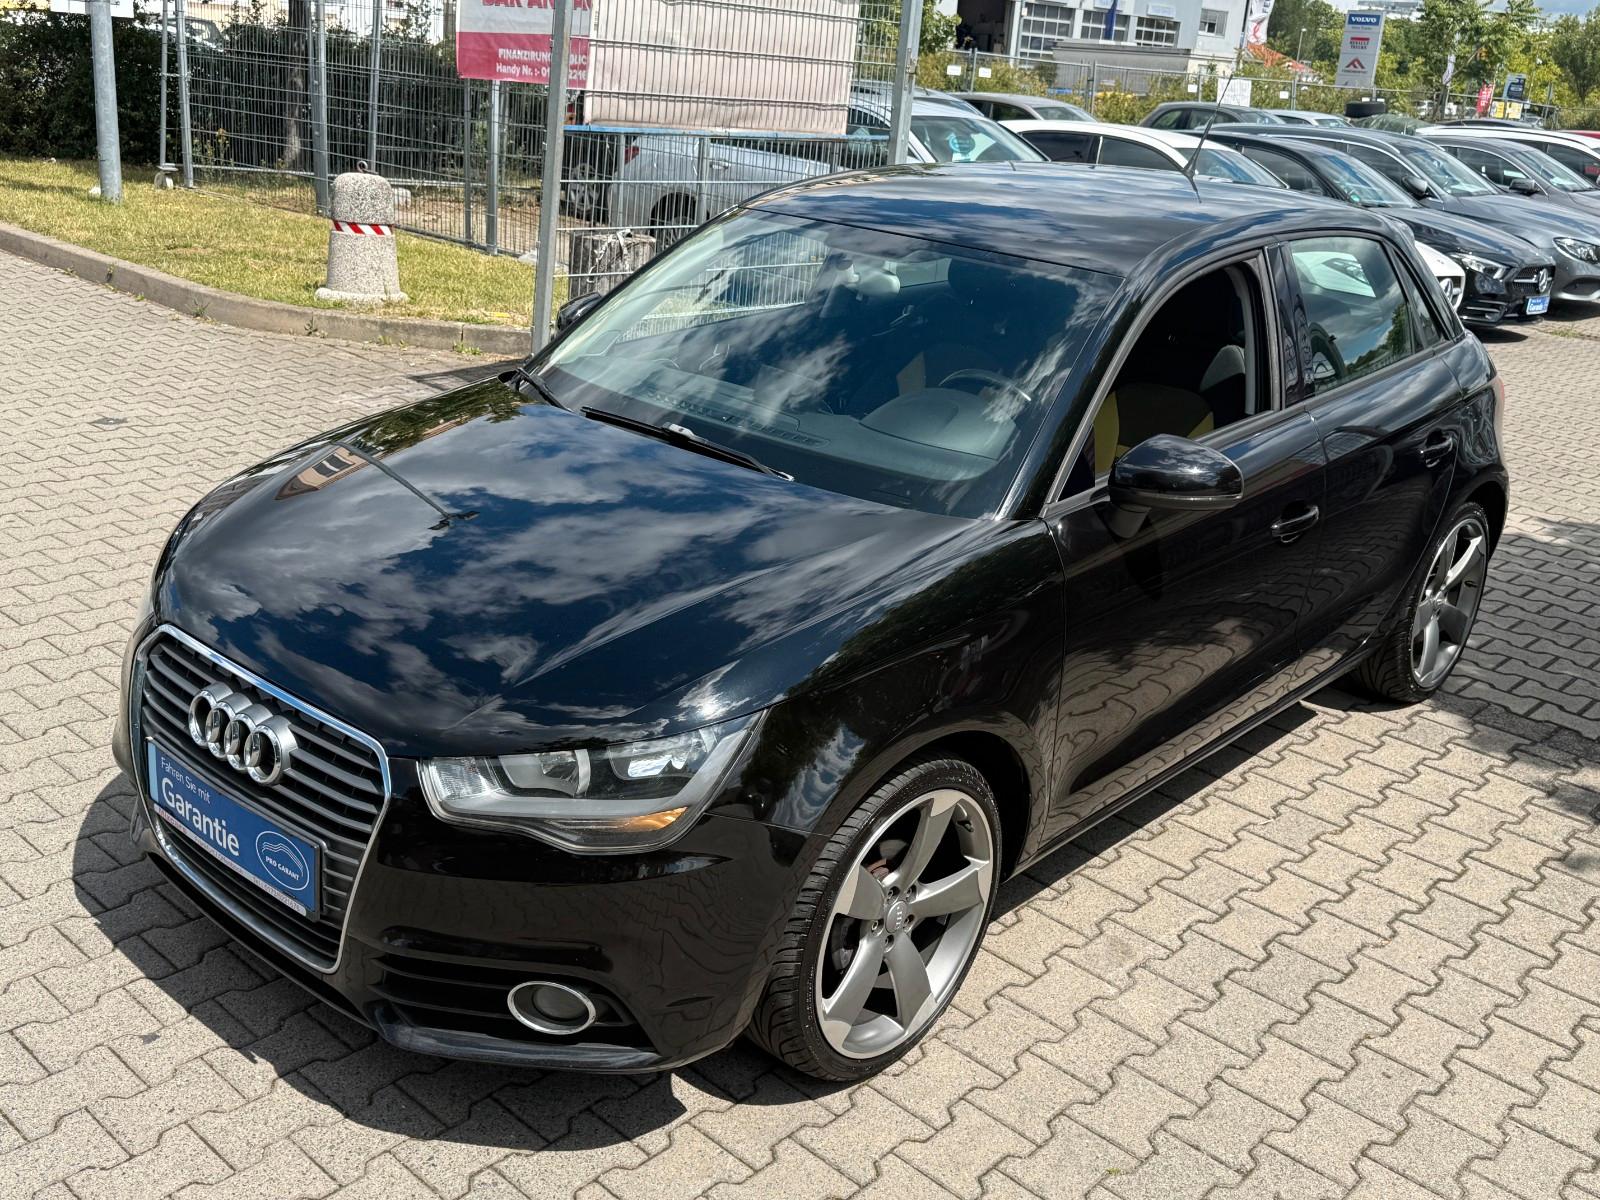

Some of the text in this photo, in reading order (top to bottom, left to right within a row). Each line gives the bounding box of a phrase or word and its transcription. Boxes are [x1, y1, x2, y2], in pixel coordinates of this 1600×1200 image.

[496, 62, 520, 77] Handy
[522, 66, 533, 76] Nr.
[161, 756, 211, 804] Fahren Sie mit
[162, 777, 240, 857] Garantie
[265, 855, 300, 881] PRO GARANT
